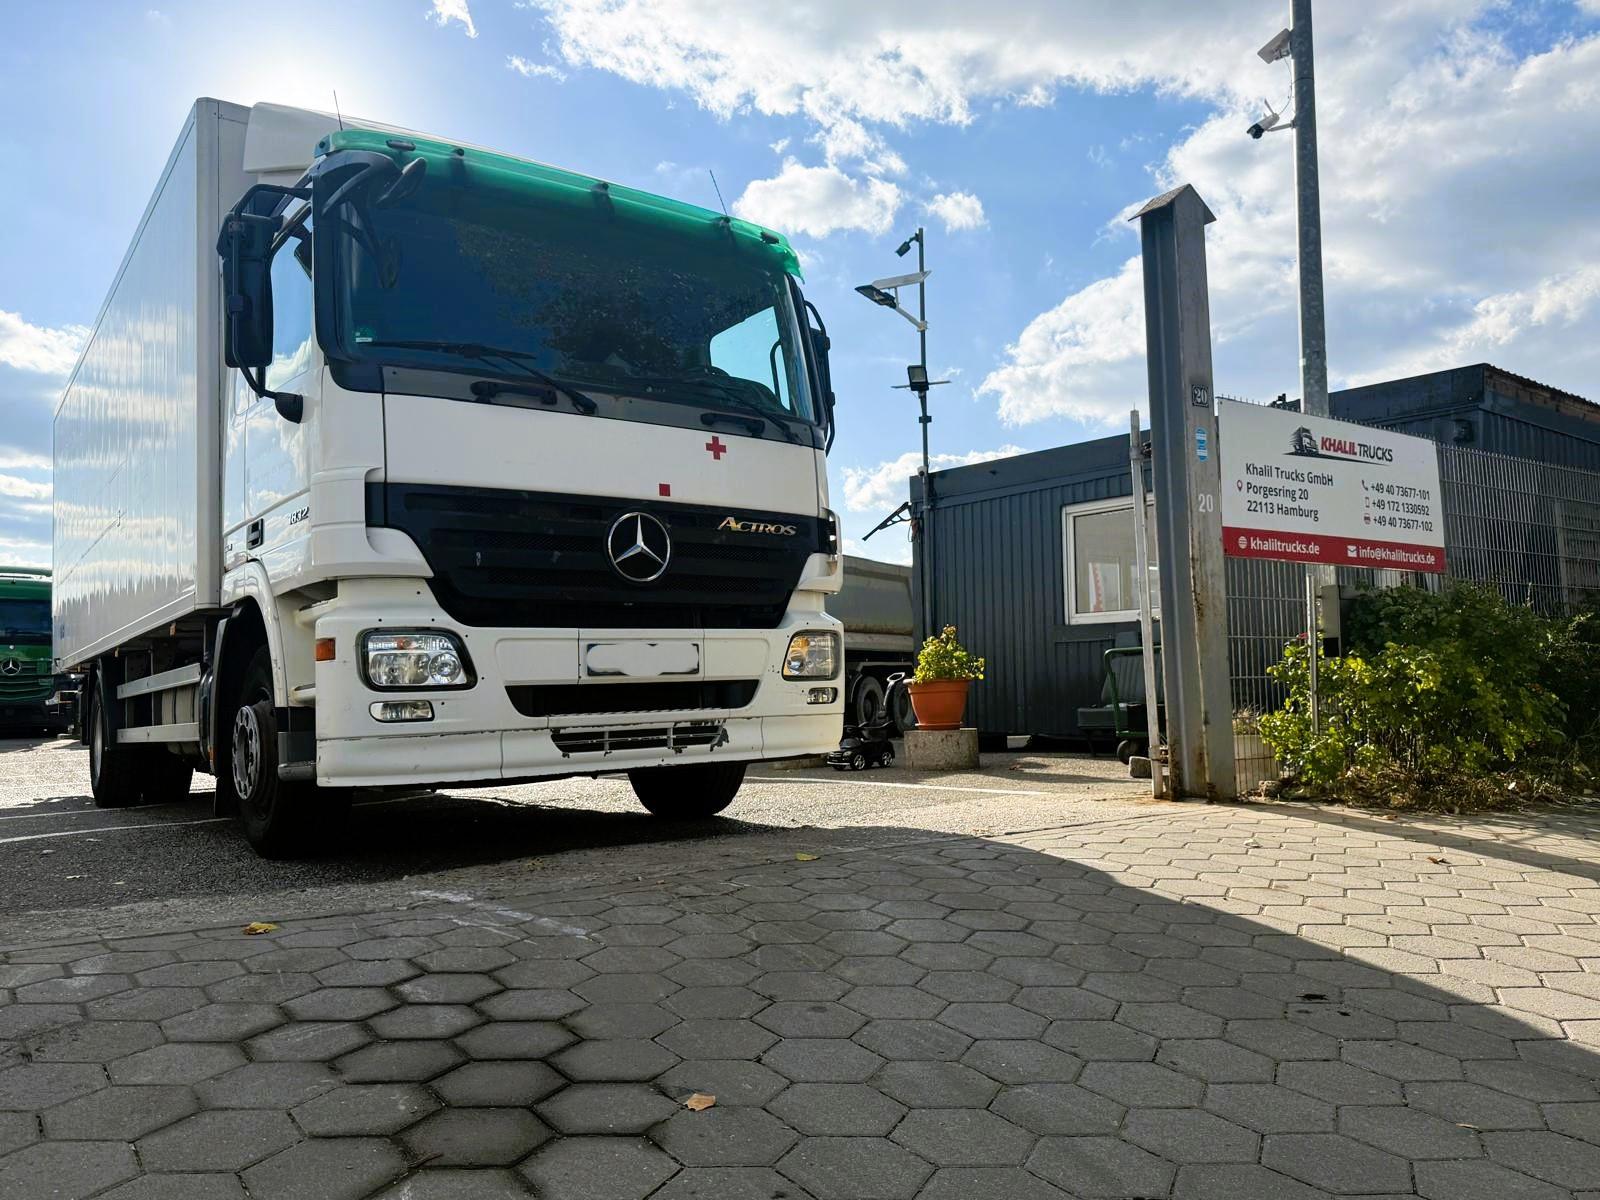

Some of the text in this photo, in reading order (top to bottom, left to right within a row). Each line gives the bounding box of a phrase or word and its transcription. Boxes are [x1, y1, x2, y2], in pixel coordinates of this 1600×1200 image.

[1245, 462, 1334, 487] Khalil Trucks GmbH
[1246, 481, 1309, 502] Porgesring 20
[1370, 482, 1430, 501] +49 40 73677-101
[1198, 493, 1214, 513] 20
[1247, 499, 1319, 522] 22113 Hamburg
[1372, 499, 1430, 516] +49 172 1330592
[1373, 515, 1433, 532] +49 40 73677-102
[1250, 536, 1320, 554] khaliltrucks.de
[1359, 546, 1436, 564] info@khaliltrucks.de
